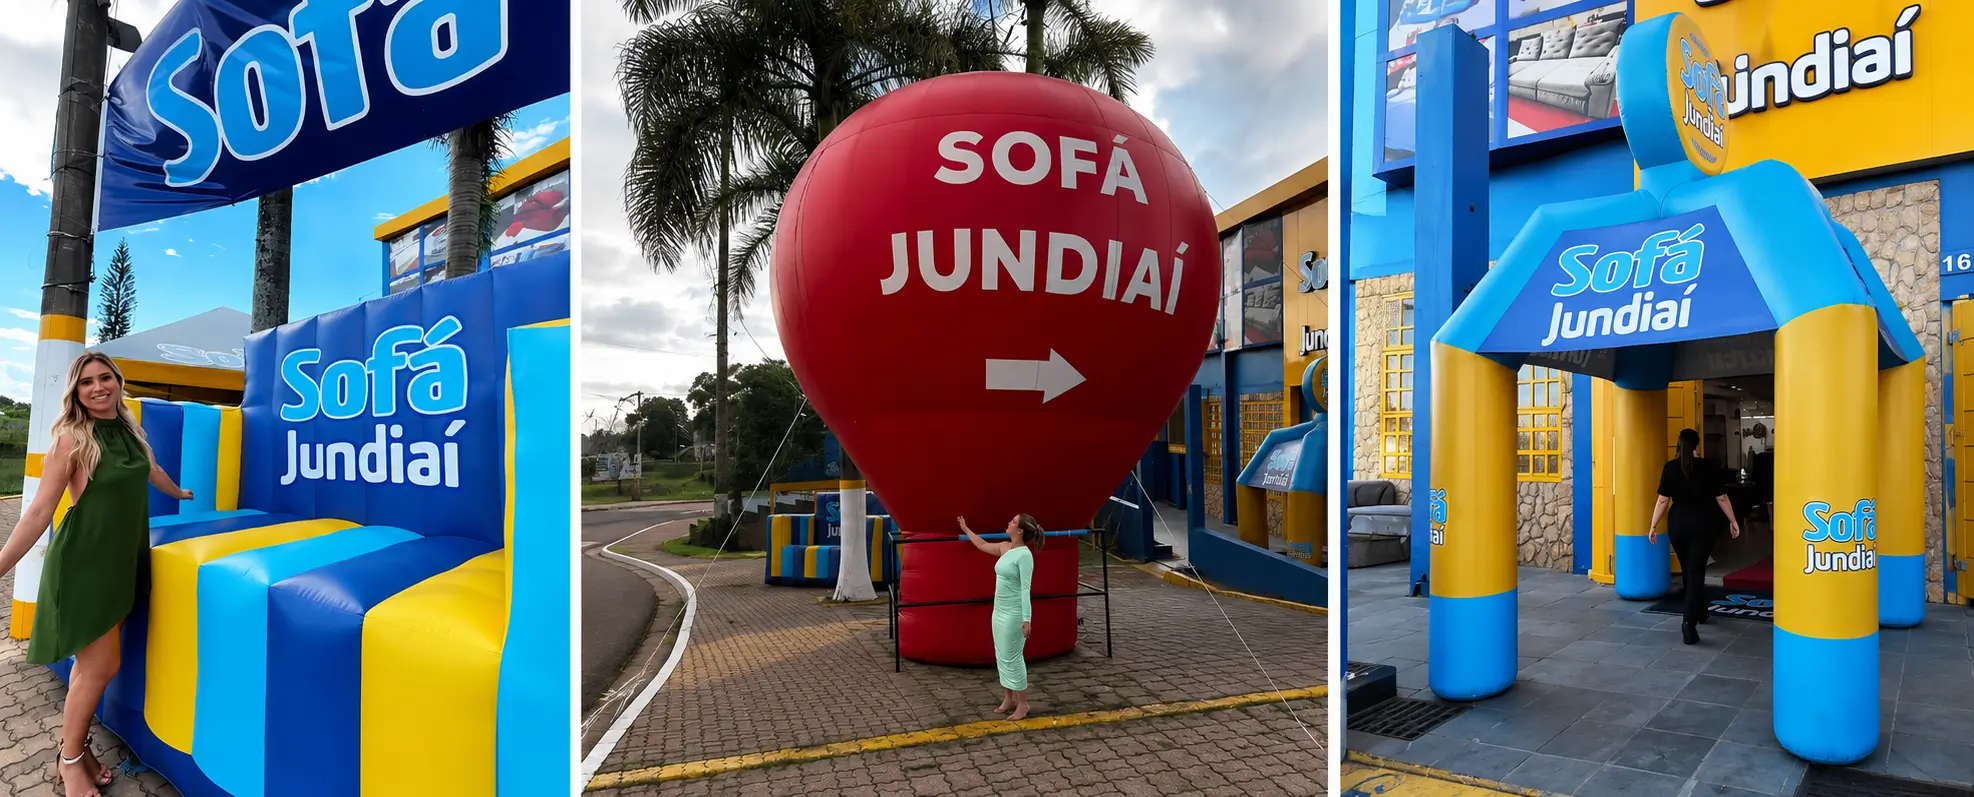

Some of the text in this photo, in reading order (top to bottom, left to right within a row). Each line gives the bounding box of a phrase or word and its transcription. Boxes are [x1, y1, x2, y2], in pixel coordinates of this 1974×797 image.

[934, 131, 1148, 205] SOFÁ
[880, 228, 1189, 315] JUNDIAÍ
[1551, 223, 1704, 296] Sofá
[1943, 253, 1971, 272] 16
[1541, 283, 1697, 347] Jundiaí
[280, 315, 468, 422] Sofá
[280, 419, 466, 488] Jundiaí
